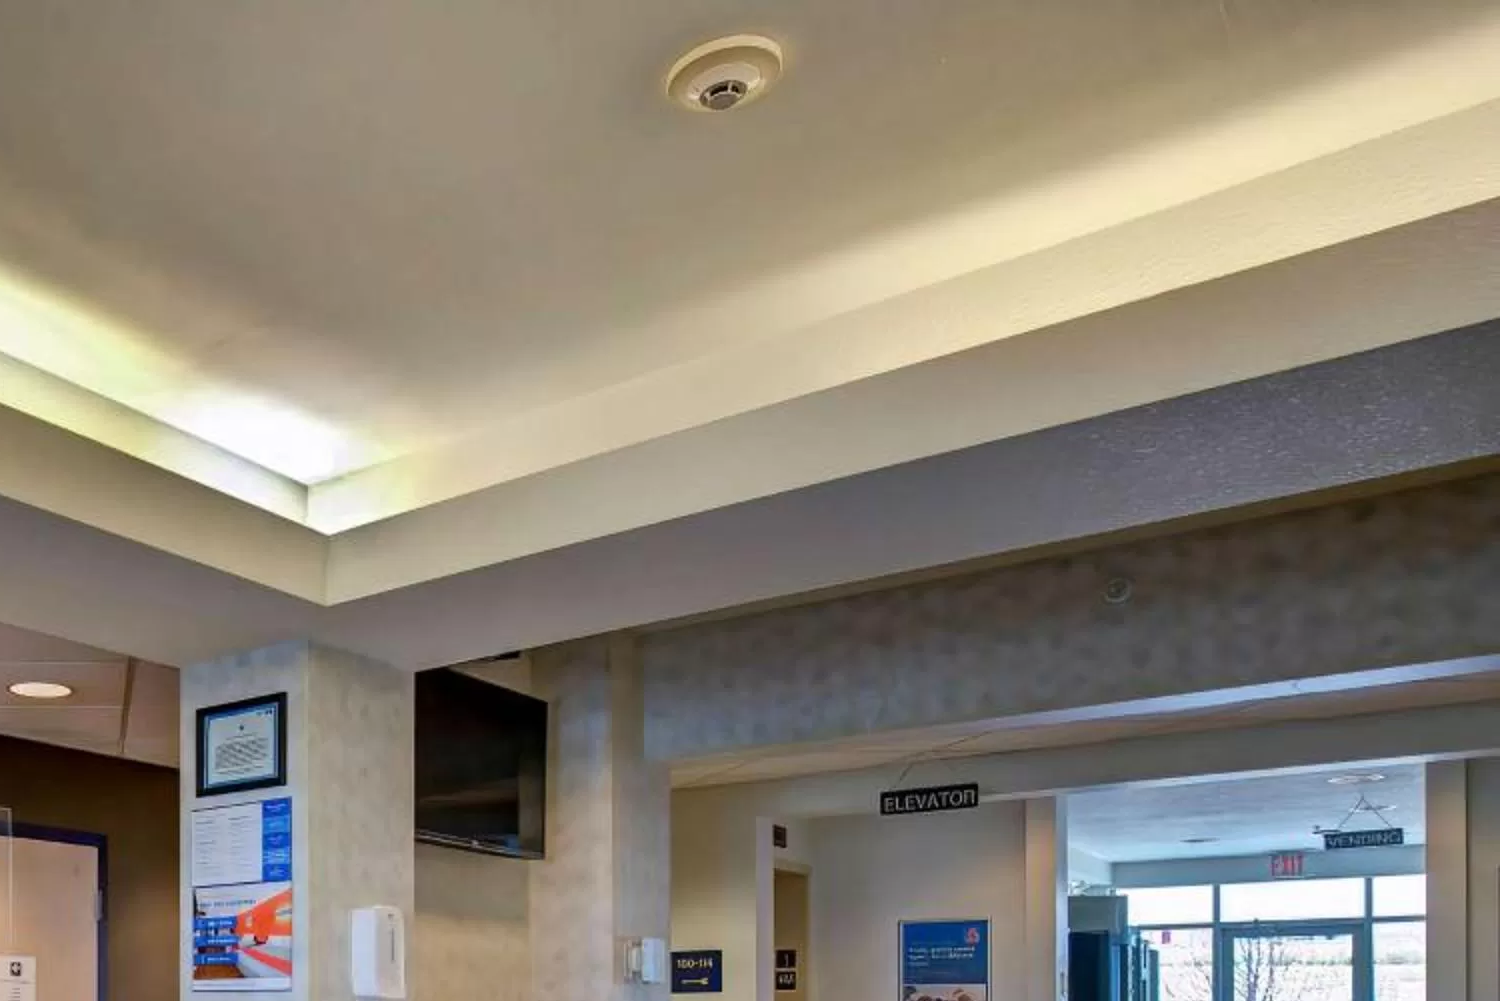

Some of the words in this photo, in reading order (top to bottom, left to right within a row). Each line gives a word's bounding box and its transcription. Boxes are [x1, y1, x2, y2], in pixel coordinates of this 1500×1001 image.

[883, 788, 976, 813] ELEVATOR
[1326, 831, 1401, 848] VENDING
[1270, 852, 1304, 876] EXIT
